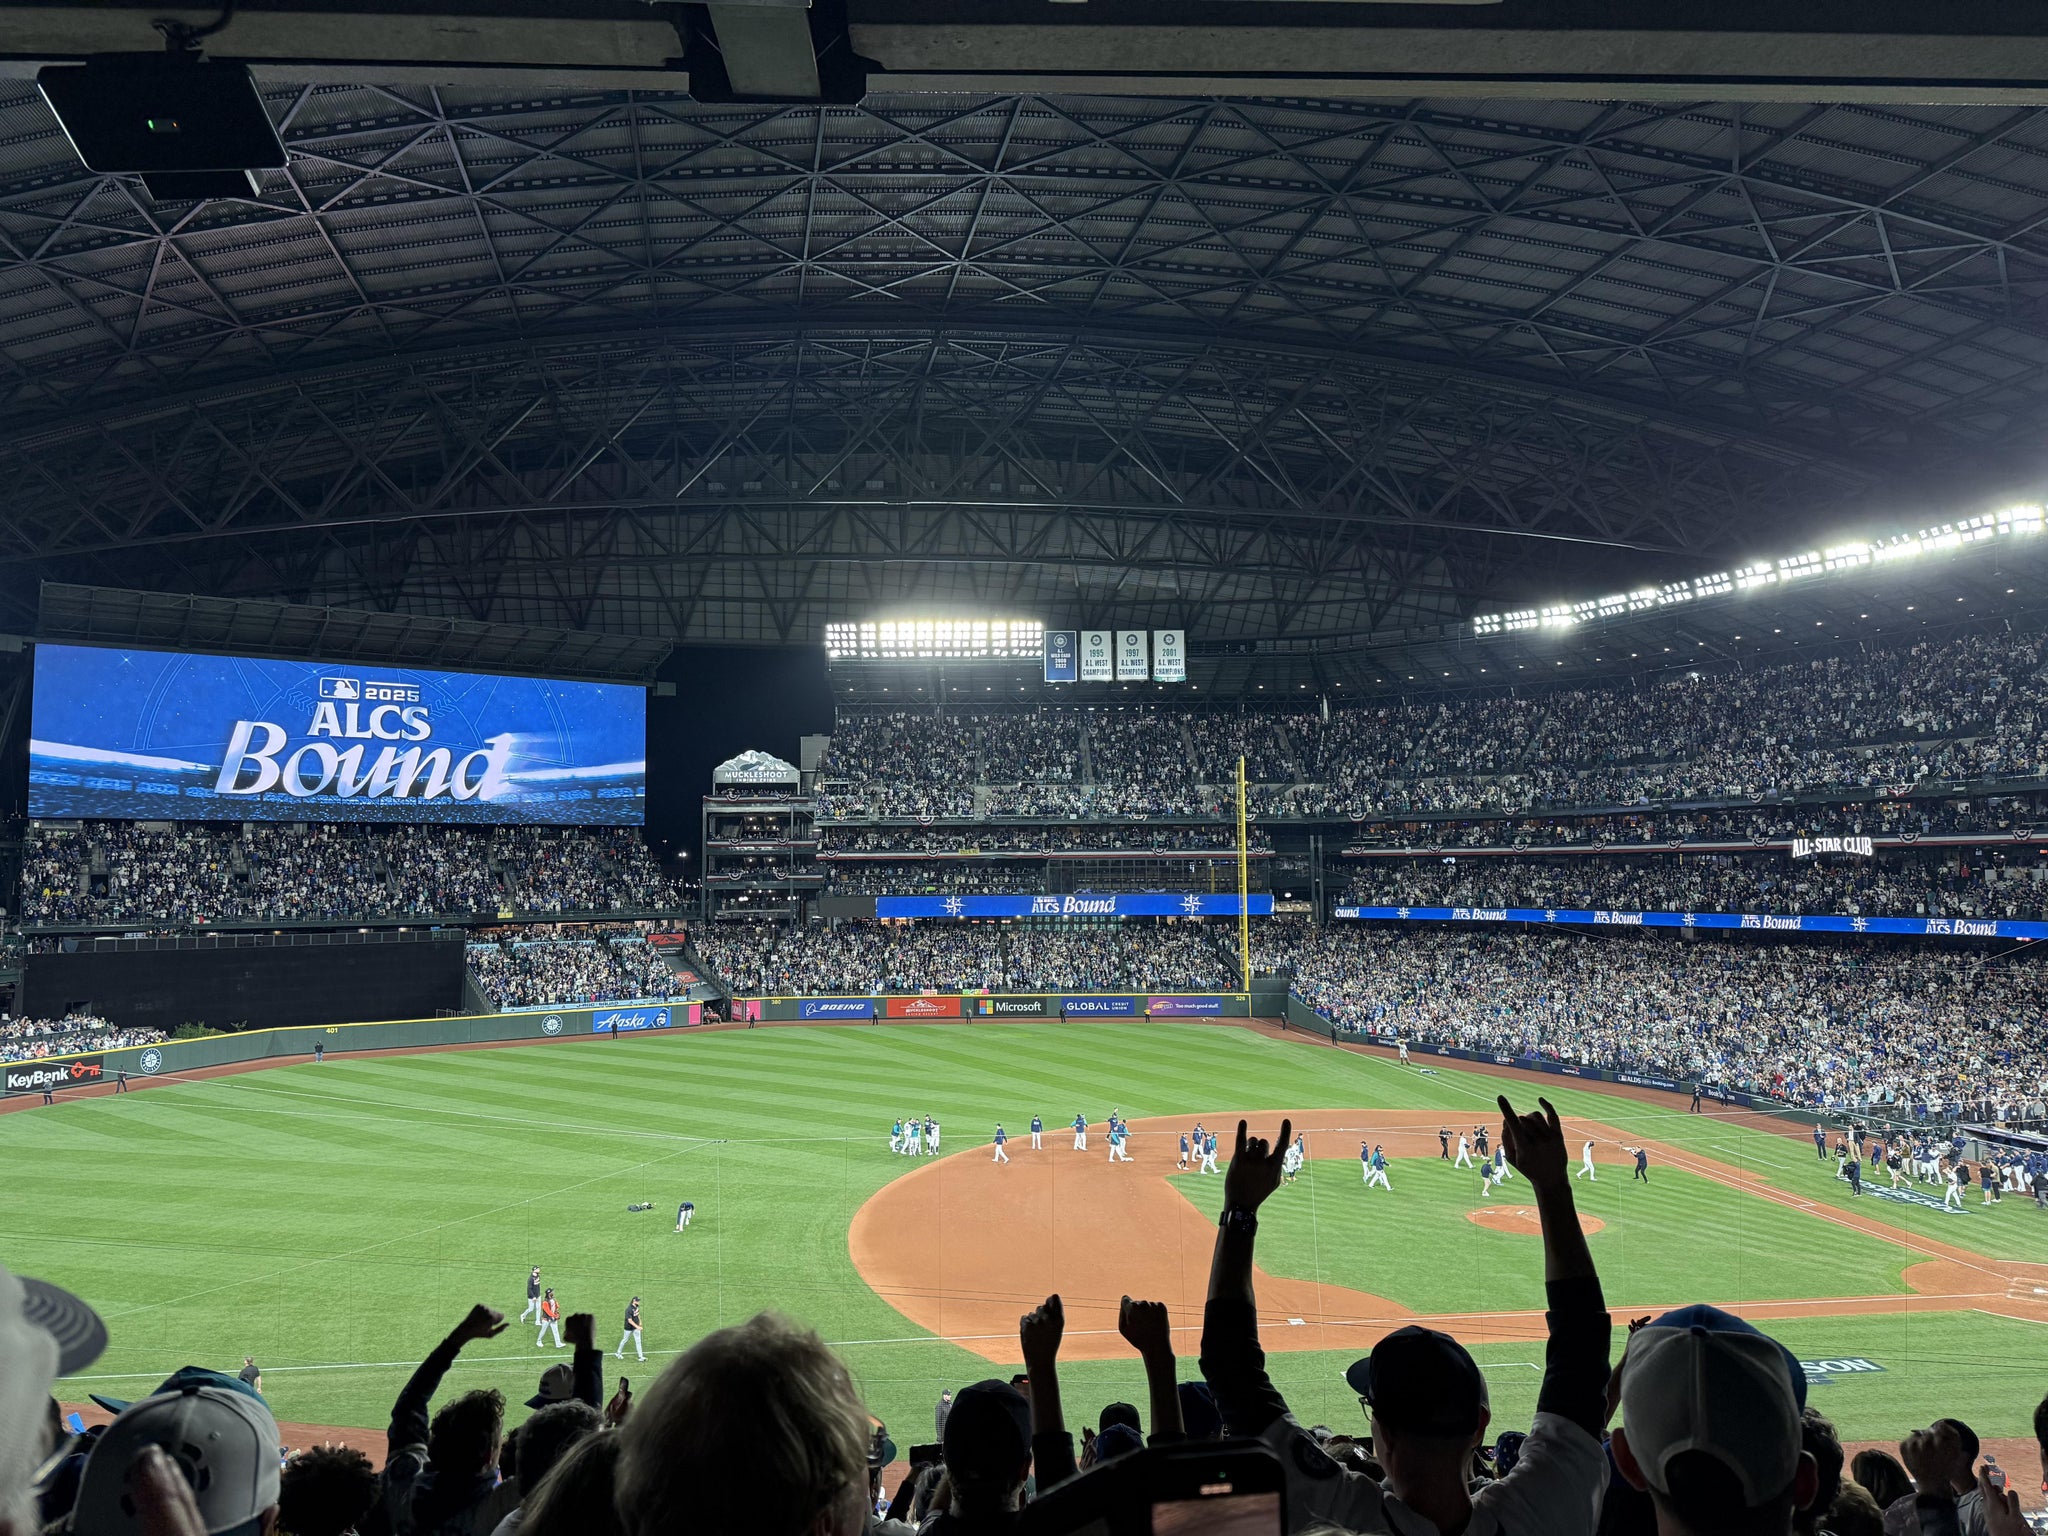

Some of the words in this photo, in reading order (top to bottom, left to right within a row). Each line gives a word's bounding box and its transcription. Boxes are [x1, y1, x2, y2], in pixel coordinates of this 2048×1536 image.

[1125, 648, 1139, 657] 1997
[1161, 648, 1177, 657] 2001
[1095, 659, 1108, 667] WEST
[1167, 658, 1181, 666] WEST
[1082, 668, 1111, 676] CHAMPIONS
[1118, 668, 1147, 676] CHAMPIONS
[1155, 667, 1184, 676] CHAMPIONS
[365, 687, 420, 703] 2025
[306, 701, 432, 742] ALCS
[213, 720, 516, 801] Bound
[1843, 836, 1873, 856] CLUB
[1031, 902, 1060, 914] ALCS
[1062, 895, 1117, 914] Bound
[1472, 908, 1507, 921] Bound
[1593, 914, 1610, 924] ALCS
[1611, 911, 1643, 925] Bound
[1741, 918, 1761, 928] ALCS
[1762, 914, 1802, 930] Bound
[1925, 924, 1951, 934] ALCS
[1953, 919, 1998, 936] Bound
[819, 1003, 866, 1011] BOEING
[995, 1001, 1042, 1012] Microsoft
[1066, 1002, 1110, 1011] GLOBAL
[596, 1012, 647, 1029] Alaska
[7, 1067, 70, 1089] KeyBank
[1627, 1075, 1642, 1084] ALDS
